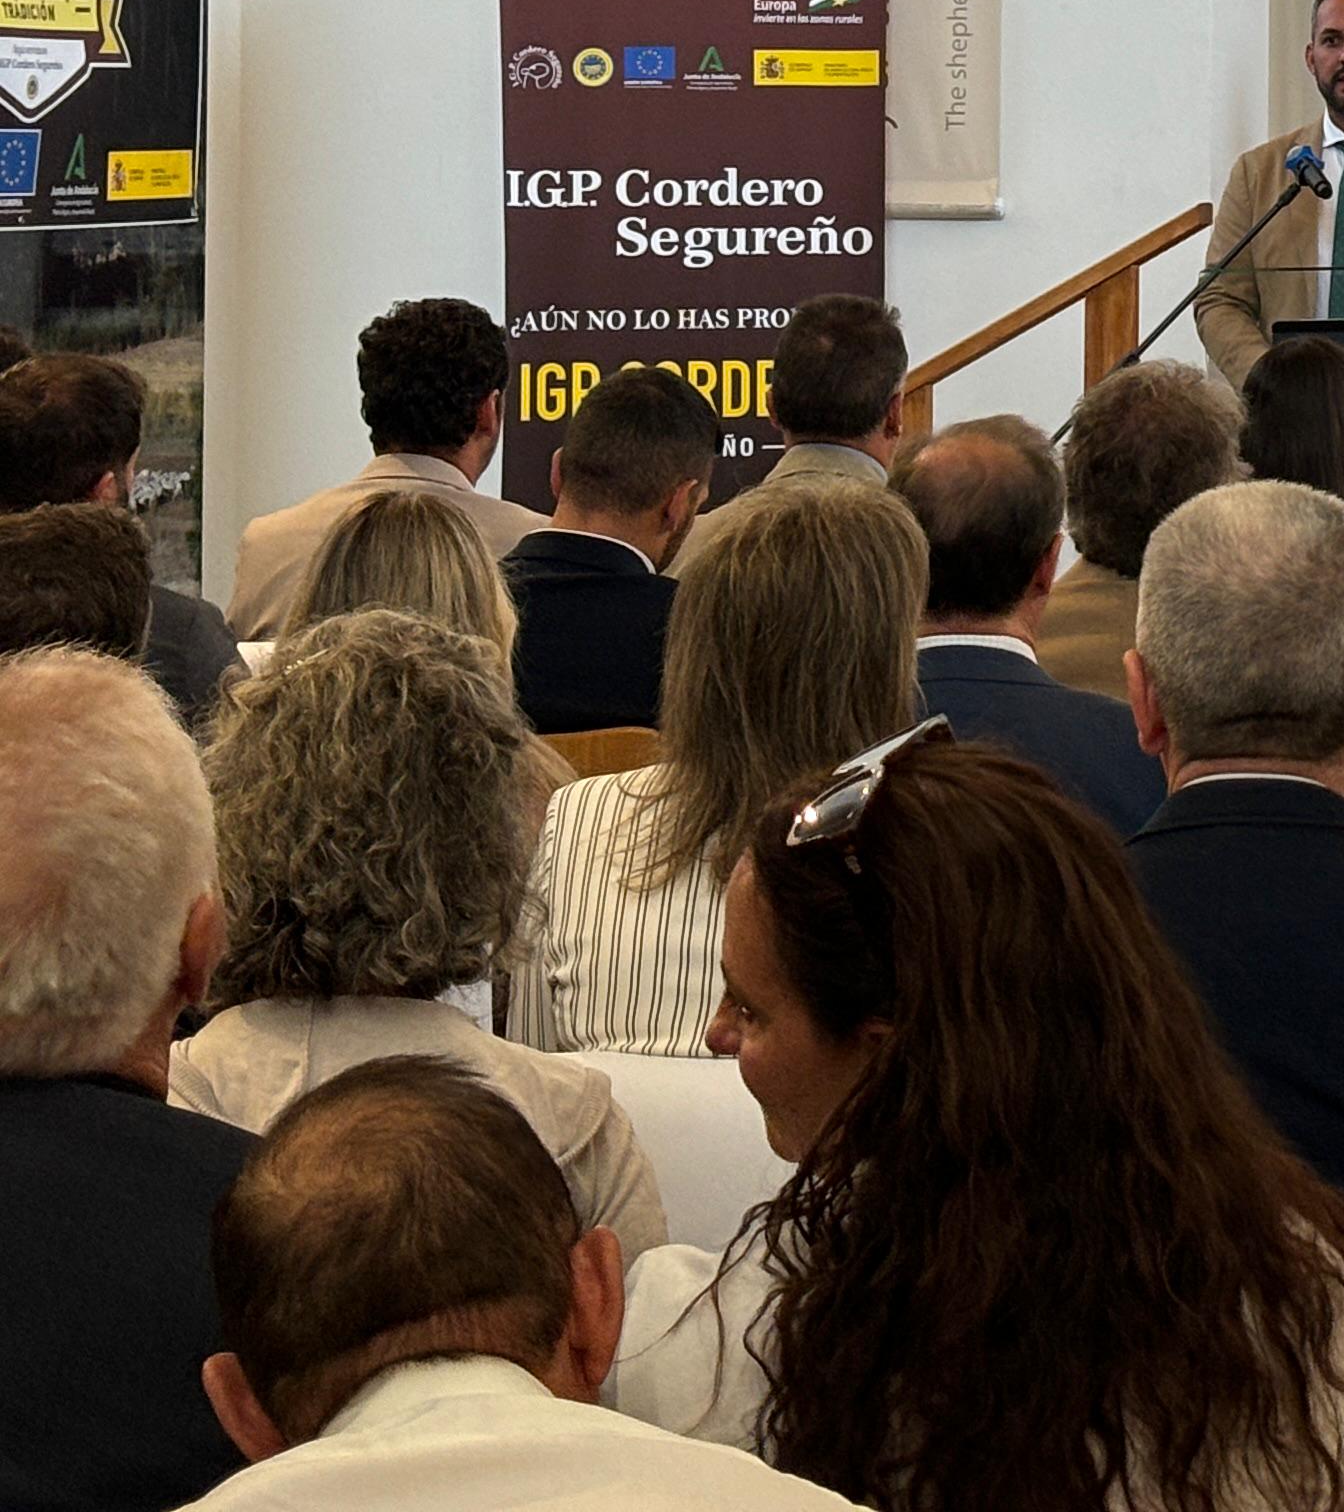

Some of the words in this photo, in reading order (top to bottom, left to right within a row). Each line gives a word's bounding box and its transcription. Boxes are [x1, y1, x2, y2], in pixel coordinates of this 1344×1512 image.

[2, 1, 55, 21] TRADICIÓN
[944, 86, 965, 131] The
[615, 167, 824, 207] Cordero
[615, 216, 873, 268] Segureño
[511, 305, 579, 338] ¿AÚN
[587, 309, 626, 330] NO
[634, 309, 670, 330] LO
[678, 308, 729, 329] HAS
[738, 307, 794, 329] PRO
